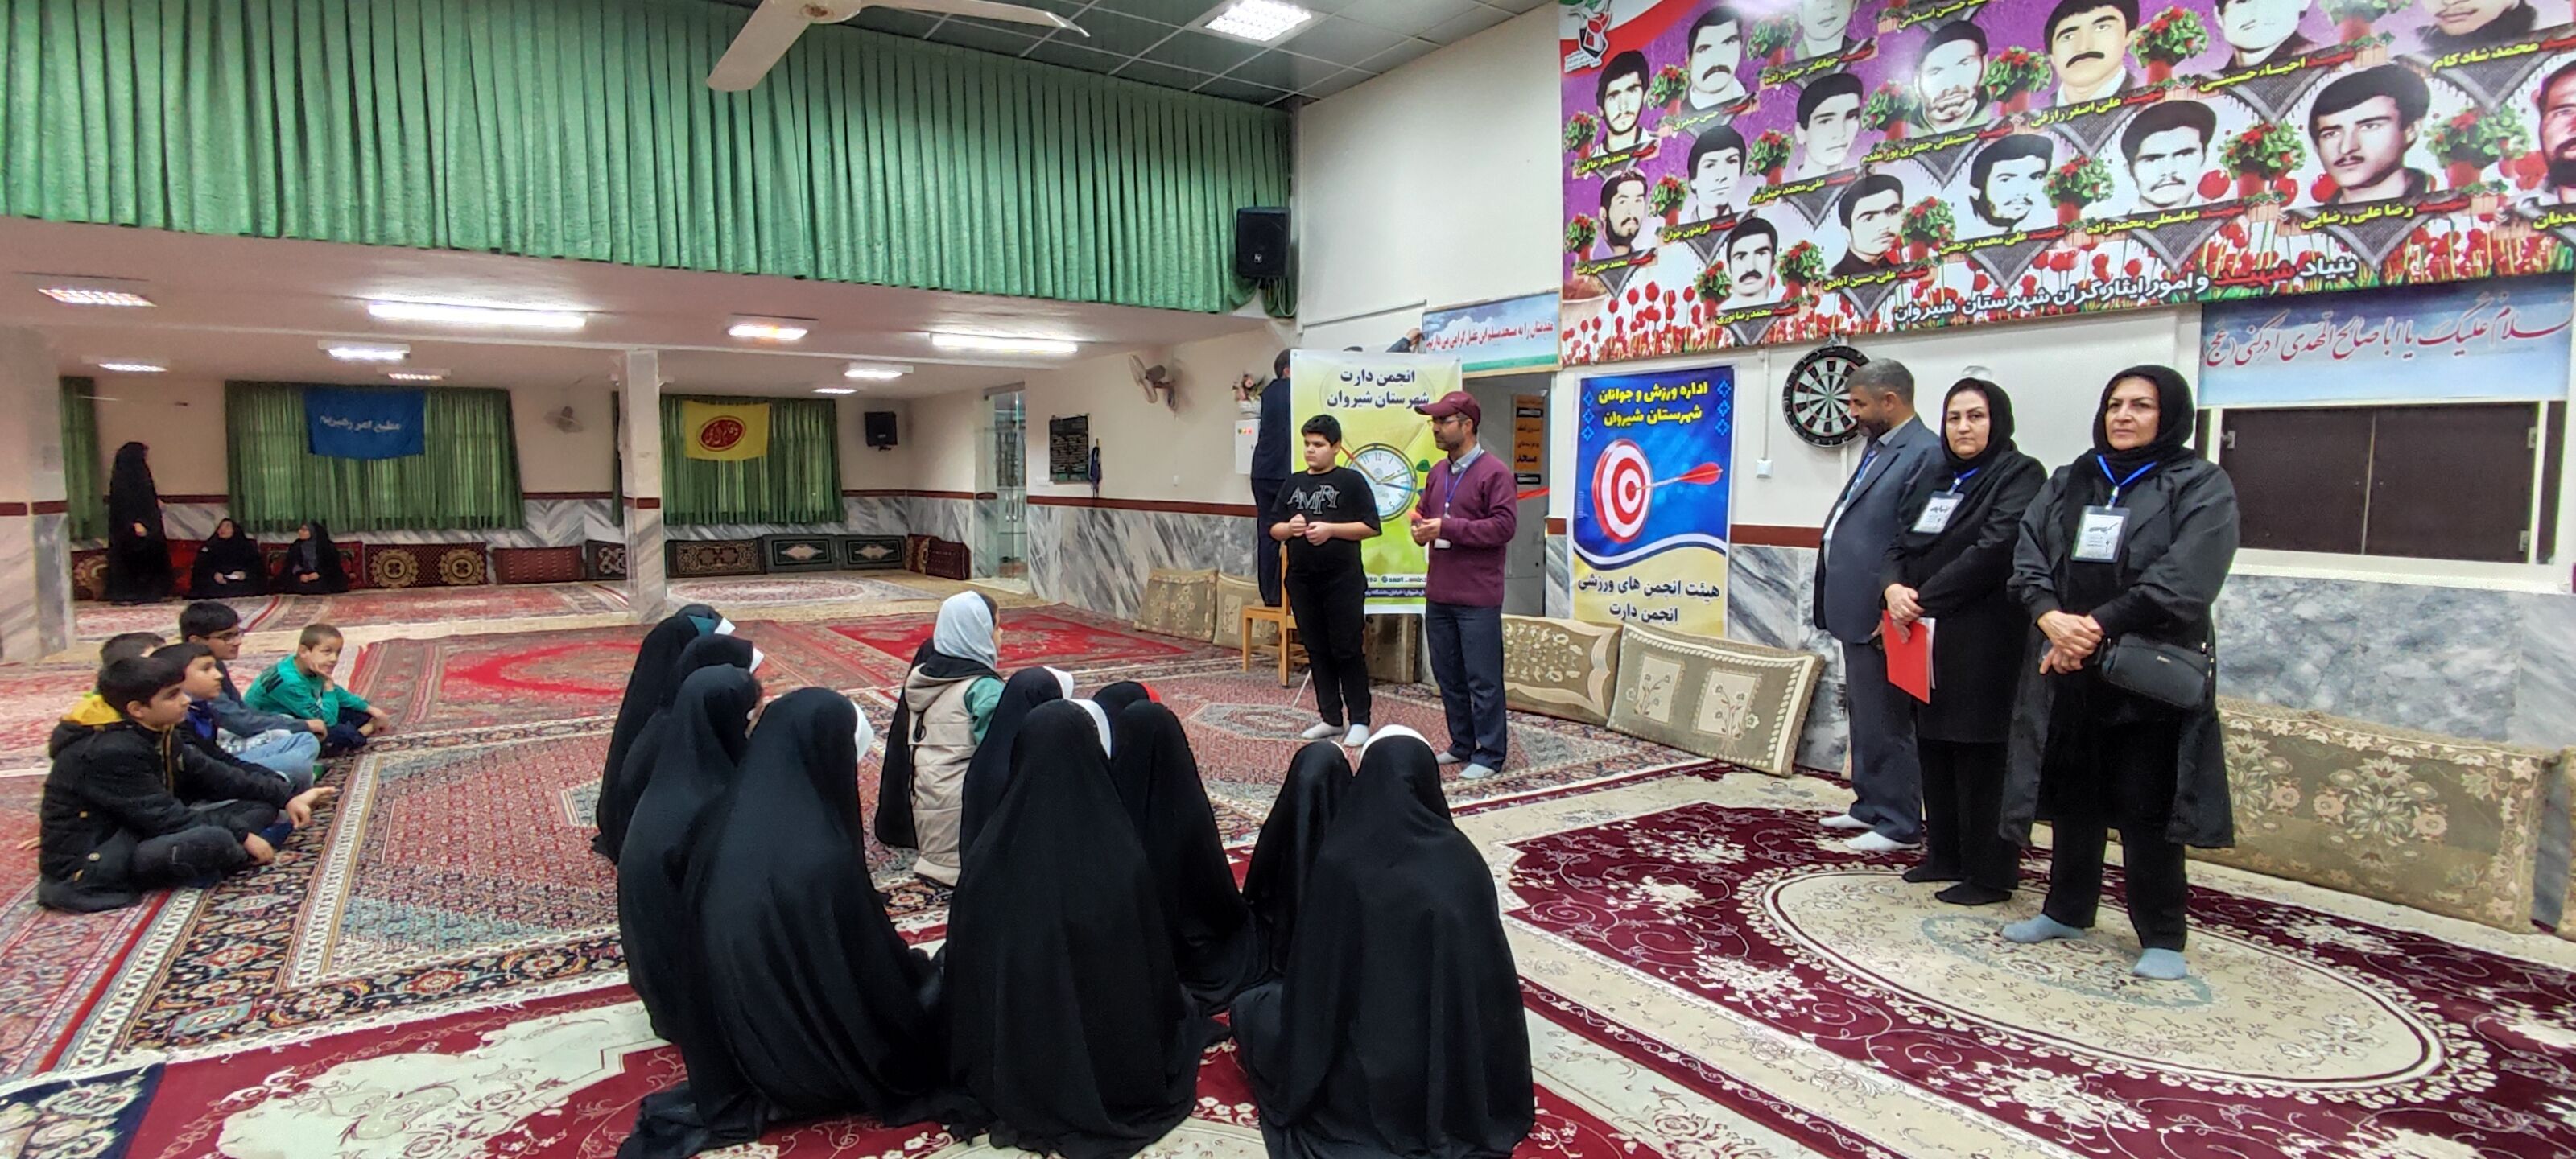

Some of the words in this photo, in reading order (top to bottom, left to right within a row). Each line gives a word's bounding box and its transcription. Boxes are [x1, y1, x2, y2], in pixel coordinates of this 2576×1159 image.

[2491, 43, 2539, 59] محمد
[2199, 71, 2257, 93] حسینی
[2066, 102, 2095, 120] اصغر
[2095, 97, 2122, 113] علی
[1611, 153, 1630, 163] محمد
[1900, 142, 1933, 158] جعفری
[1782, 185, 1806, 195] محمد
[1807, 179, 1826, 192] علی
[2146, 210, 2200, 229] عباسعلی
[2351, 206, 2383, 224] علی
[2384, 203, 2414, 218] رضا
[2086, 219, 2146, 235] محمدزاده
[2300, 211, 2350, 229] رضایی
[1663, 231, 1682, 242] جوان
[1682, 223, 1711, 239] فریدون
[2005, 231, 2028, 245] علی
[1975, 237, 2004, 248] محمد
[1610, 260, 1629, 269] محمد
[2300, 256, 2357, 278] بنیاد
[1823, 274, 1849, 291] آبادی
[1850, 275, 1876, 287] حسین
[1876, 270, 1897, 283] علی
[2215, 261, 2296, 287] شهید
[2054, 275, 2144, 307] ایثارگران
[2145, 272, 2194, 297] امور
[2194, 275, 2211, 294] و
[1893, 297, 1956, 321] شیروان
[1962, 287, 2050, 315] شهرستان
[1750, 309, 1772, 318] محمد
[1340, 369, 1373, 386] دارت
[1377, 369, 1415, 386] انجمن
[1327, 390, 1373, 408] شیروان
[1598, 388, 1634, 404] جوانان
[1635, 390, 1642, 402] و
[1644, 383, 1678, 402] ورزش
[1680, 381, 1708, 400] اداره
[1375, 391, 1430, 409] شهرستان
[1604, 408, 1644, 427] شیروان
[1646, 404, 1703, 424] شهرستان
[1578, 573, 1615, 592] ورزشی
[1618, 576, 1641, 594] های
[1643, 580, 1682, 599] انجمن
[1685, 581, 1719, 602] هیئت
[1609, 603, 1637, 621] دارت
[1641, 608, 1678, 625] انجمن
